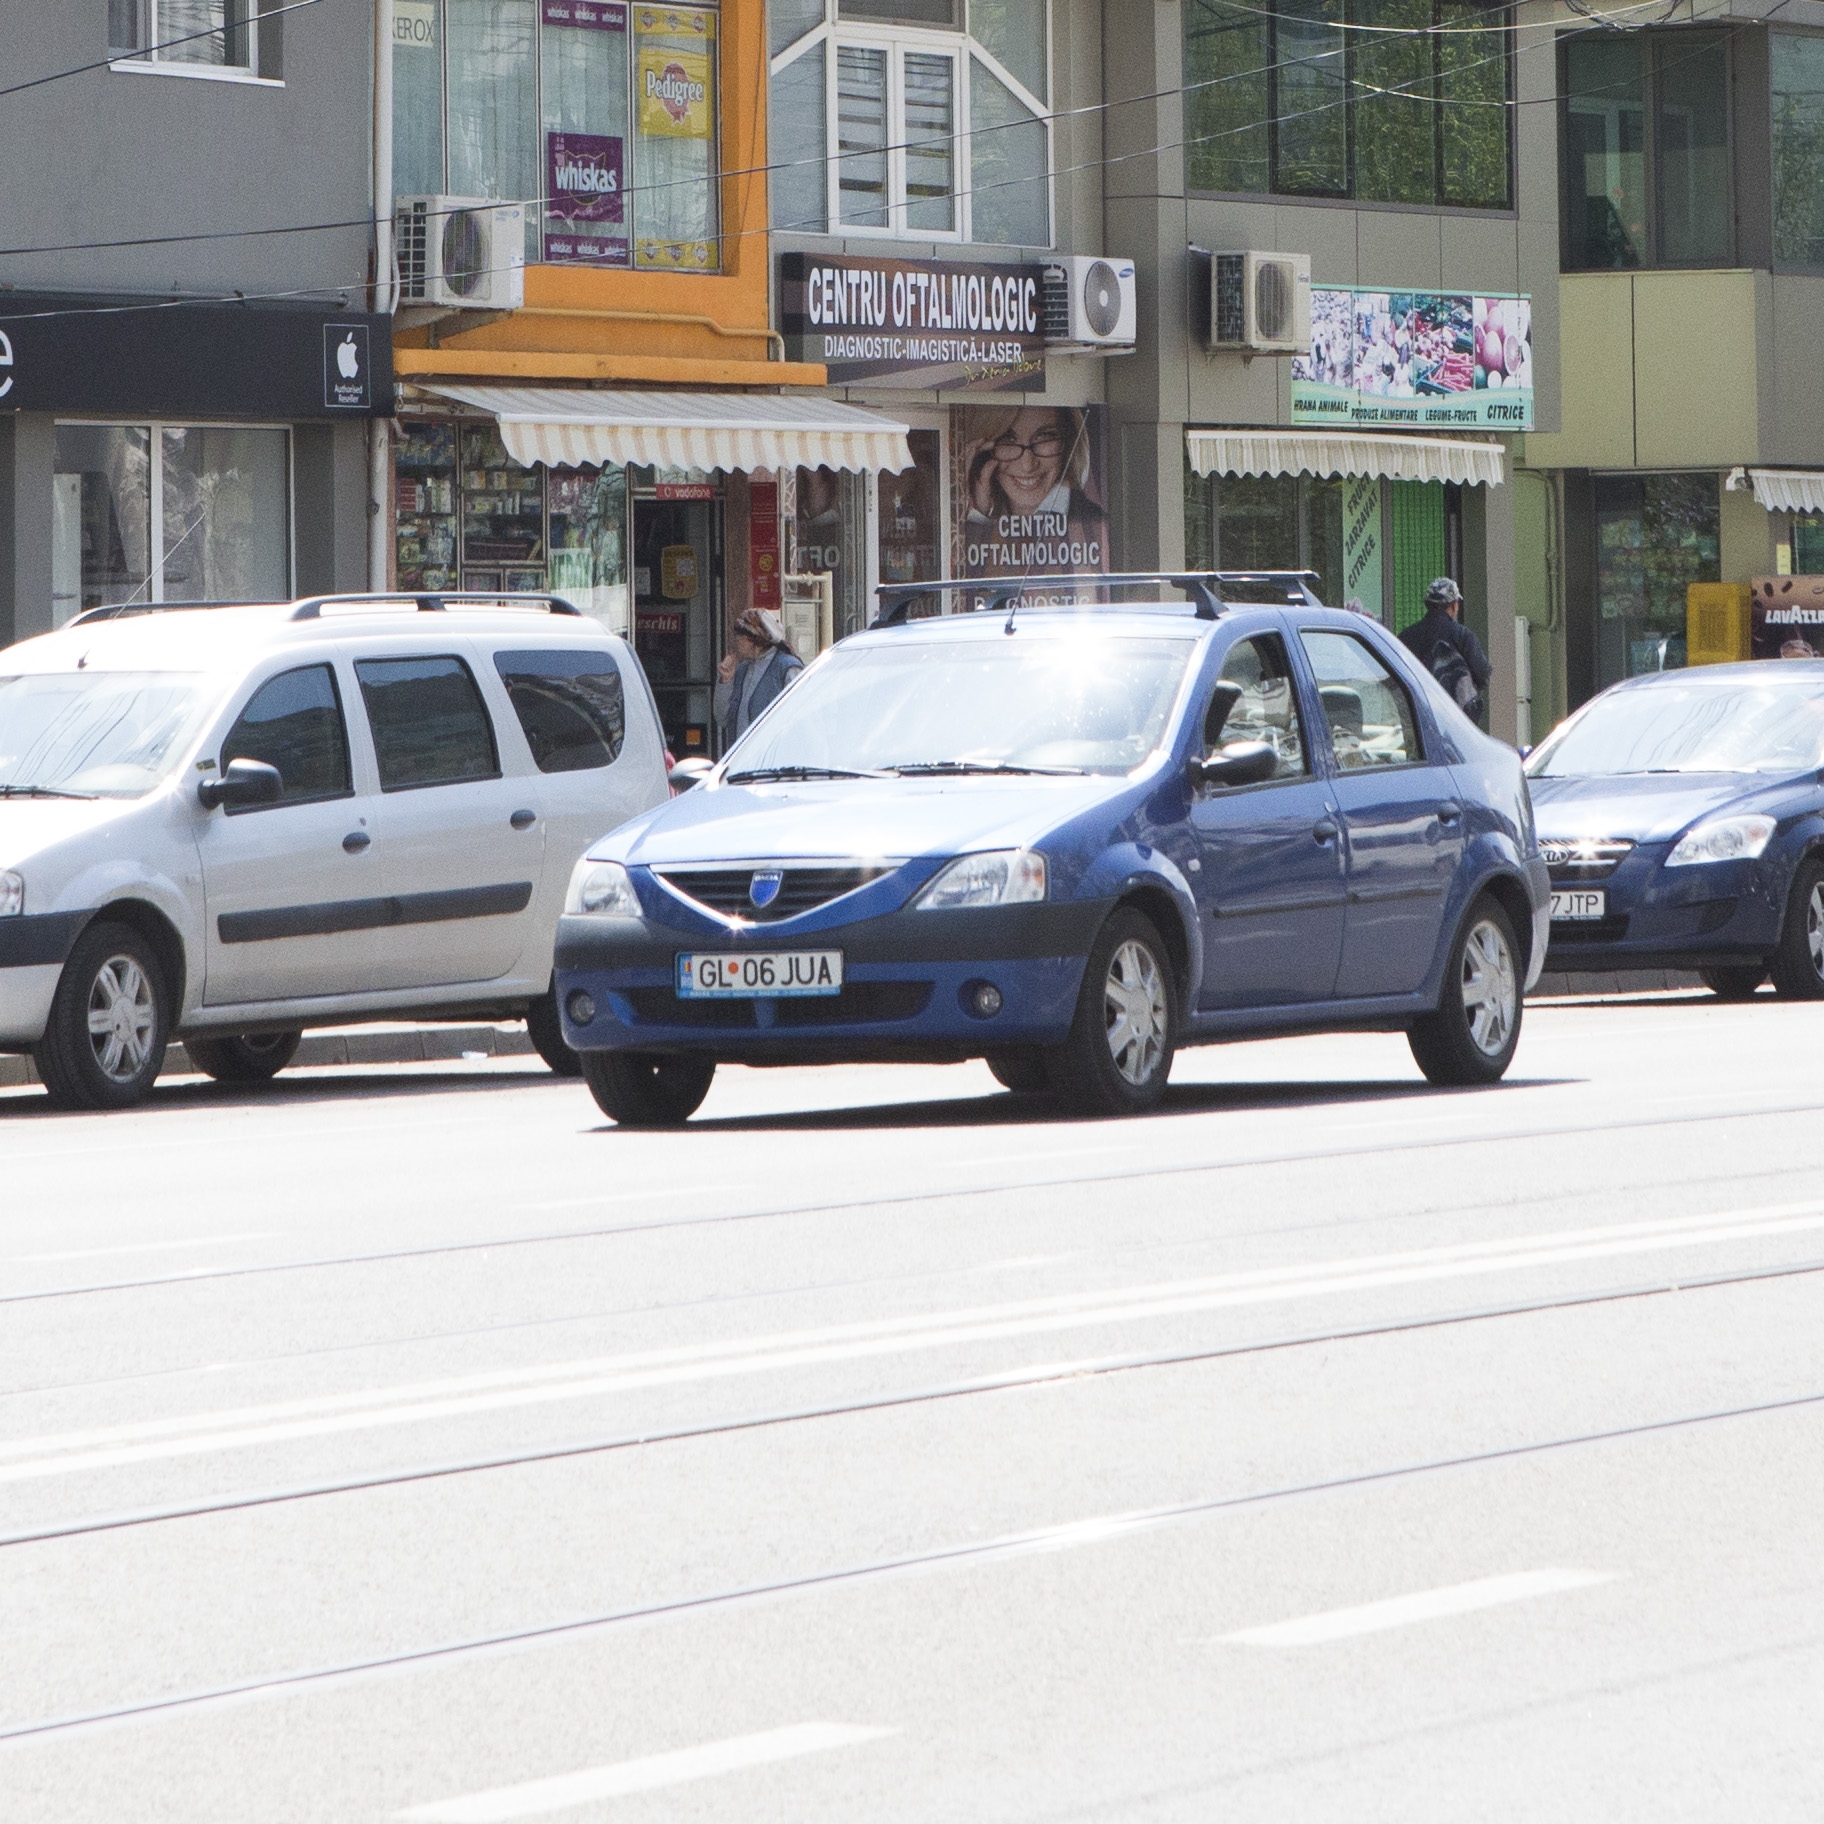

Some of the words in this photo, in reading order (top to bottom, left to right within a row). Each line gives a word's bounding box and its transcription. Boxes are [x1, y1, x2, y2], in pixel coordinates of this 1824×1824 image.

[646, 69, 704, 106] Pedigree
[555, 160, 617, 194] whiskas
[808, 267, 887, 327] CENTRU
[892, 271, 1037, 333] OFTALMOLOGIC
[1294, 399, 1317, 412] HRANA
[1318, 400, 1349, 413] ANIMALE
[1351, 408, 1380, 420] PRODUSE
[1380, 409, 1418, 422] ALIMENTARE
[1425, 409, 1477, 422] LEGUME-FRUCTE
[1487, 404, 1524, 421] CITRICE
[675, 485, 711, 499] vodafone
[1347, 472, 1370, 516] FRUCT
[998, 514, 1067, 538] CENTRU
[1345, 487, 1378, 557] ZARZAVAT
[967, 541, 1100, 567] OFTALMOLOGIC
[1348, 534, 1376, 589] CITRICE
[637, 615, 678, 631] eschis
[1564, 893, 1599, 914] JTP
[699, 959, 733, 988] GL
[743, 958, 775, 987] 06
[781, 956, 833, 987] JUA
